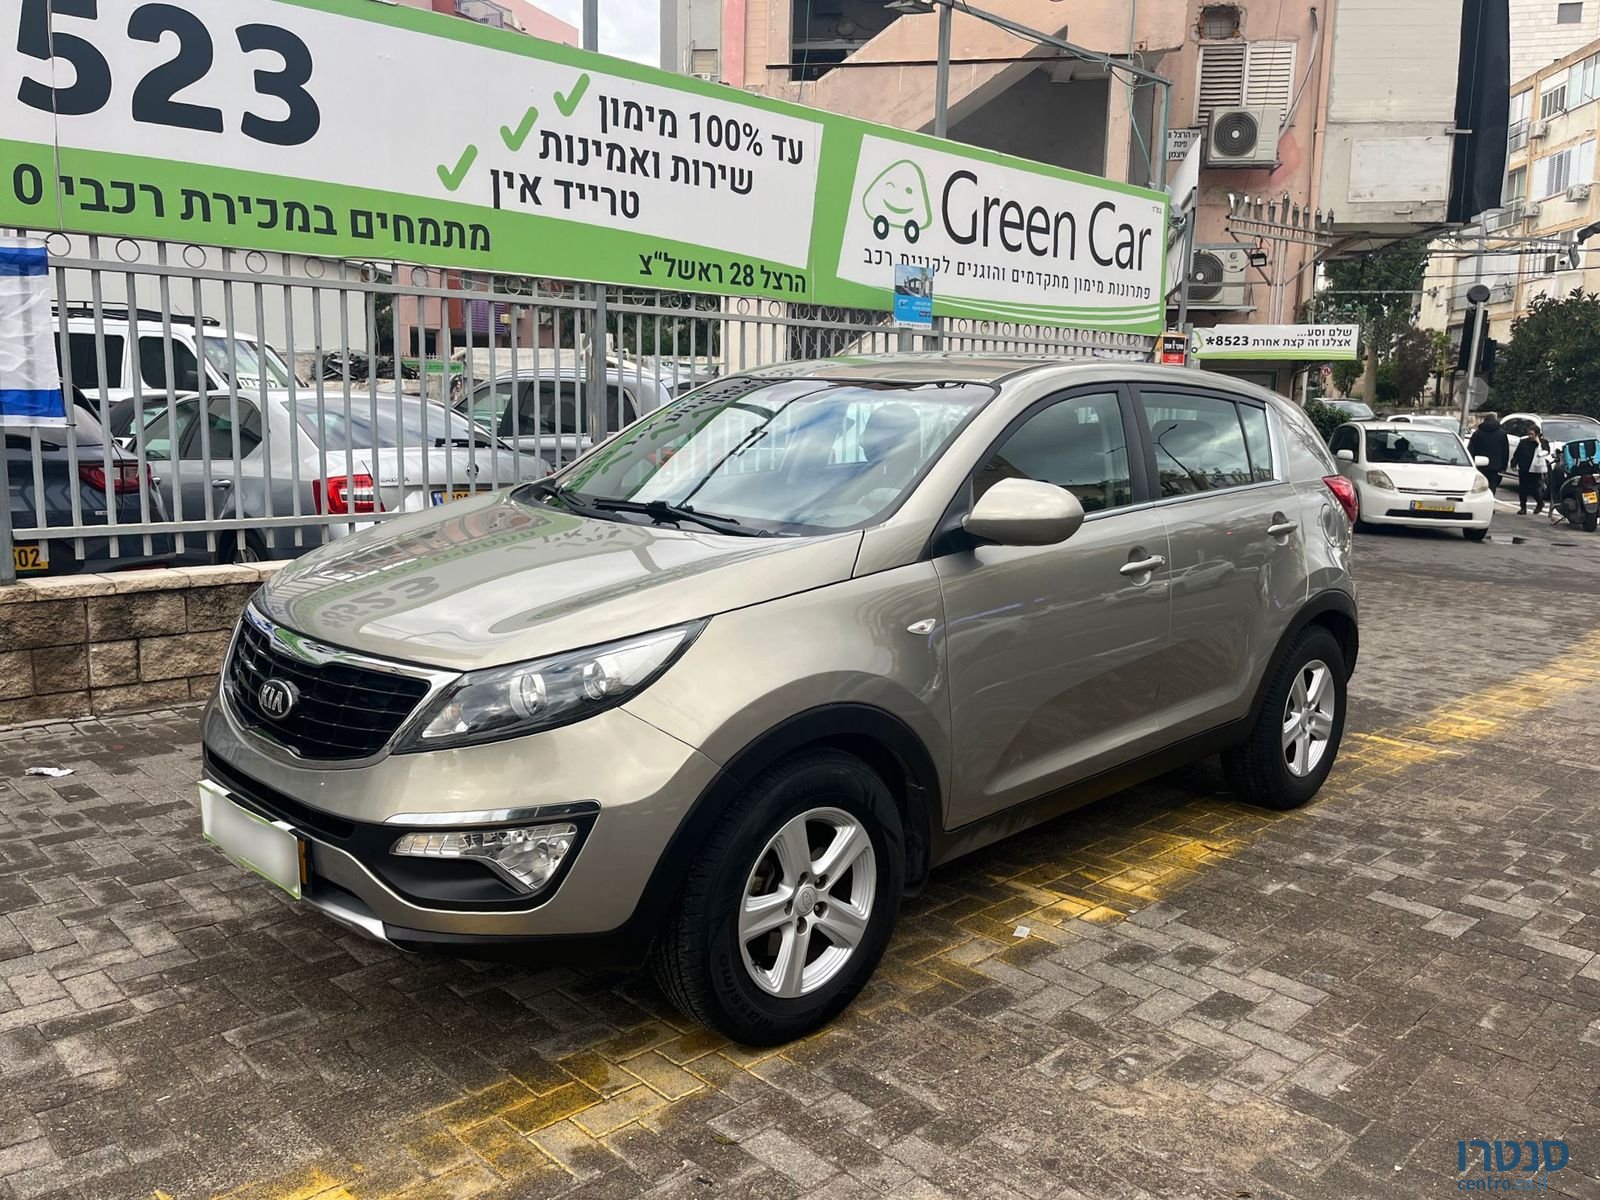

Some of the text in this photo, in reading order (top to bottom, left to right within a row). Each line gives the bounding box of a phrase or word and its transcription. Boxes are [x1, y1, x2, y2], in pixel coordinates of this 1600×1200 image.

[17, 0, 320, 145] 523
[599, 95, 803, 165] עד 100% מימון
[537, 128, 753, 195] שירות ואמינות
[490, 168, 640, 219] טרייד אין
[13, 163, 491, 252] מתמחים במכירת רכבי 0
[942, 168, 1152, 271] Green Car
[863, 248, 892, 267] רכב
[729, 262, 755, 288] 28
[760, 264, 806, 294] הרצל
[957, 261, 1006, 281] והוגנים
[1011, 268, 1069, 291] מתקדמים
[1074, 277, 1104, 294] מימון
[1107, 282, 1151, 300] פתרונות
[1252, 338, 1280, 347] אחרת
[1282, 338, 1305, 349] קצת
[1307, 338, 1320, 347] זה
[1322, 337, 1351, 347] אצלנו
[1328, 328, 1352, 337] שלם
[261, 684, 283, 713] KIA
